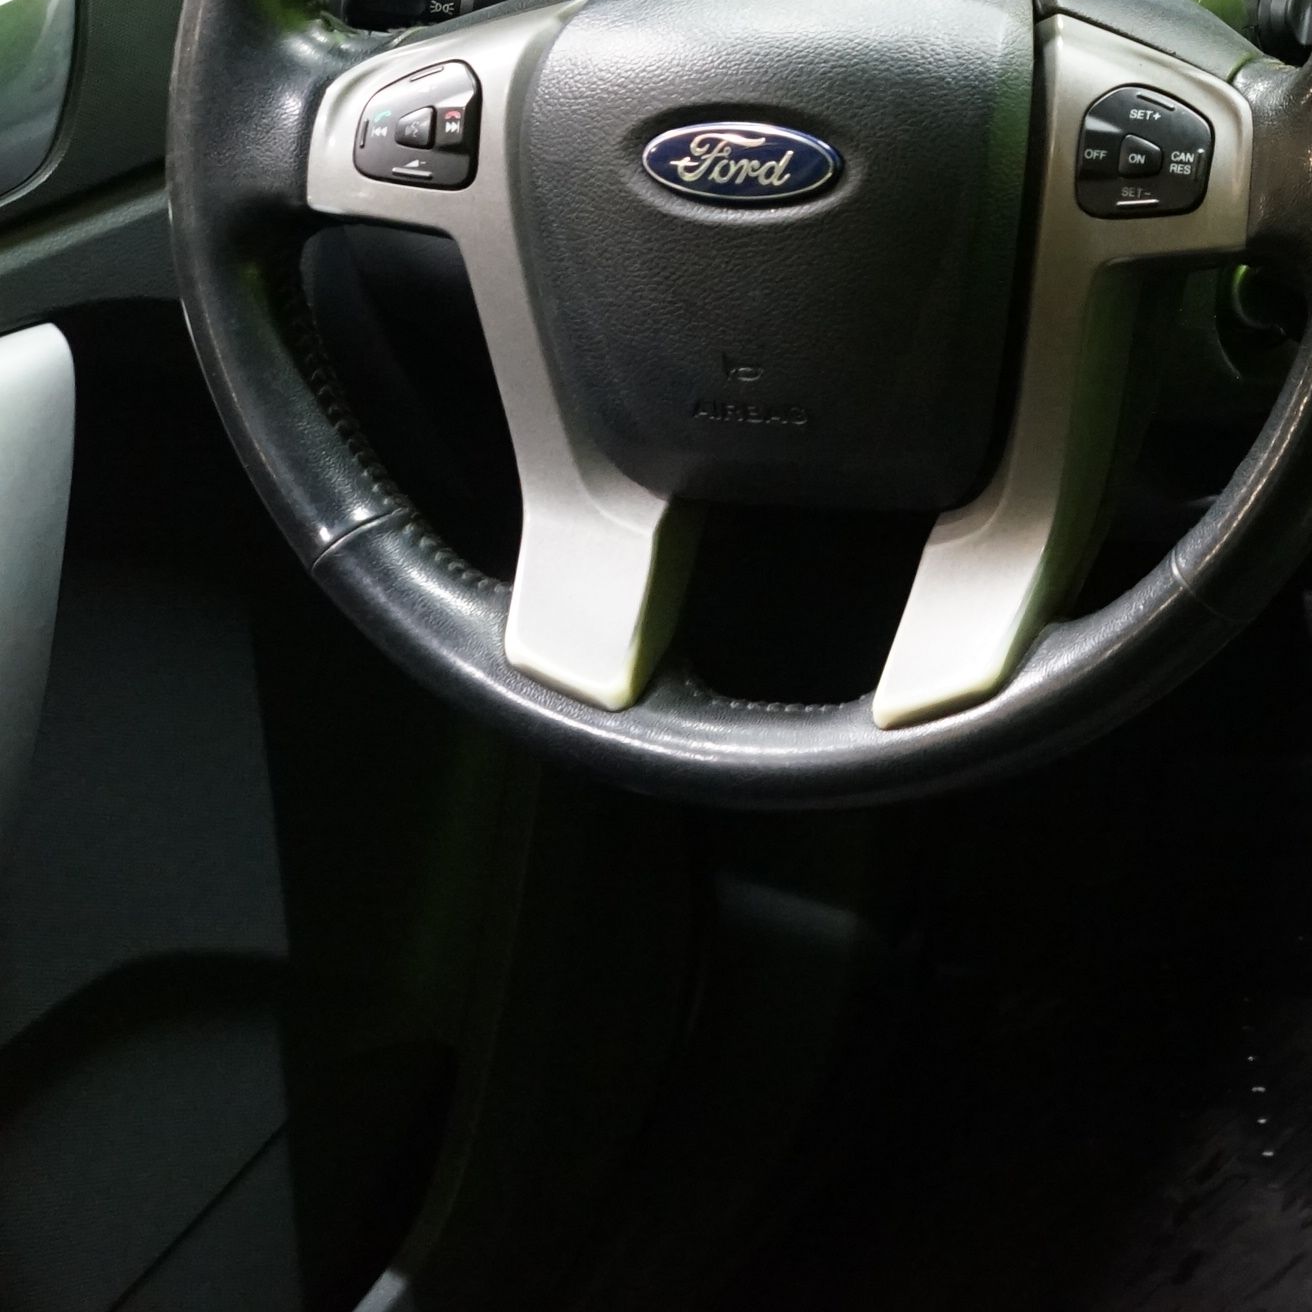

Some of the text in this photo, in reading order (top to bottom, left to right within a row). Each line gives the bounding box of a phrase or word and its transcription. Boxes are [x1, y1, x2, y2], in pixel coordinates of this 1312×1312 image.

[669, 132, 794, 186] Ford
[1084, 149, 1108, 160] OFF
[1128, 153, 1146, 165] ON
[1170, 151, 1194, 163] CAN
[1169, 163, 1191, 175] RES
